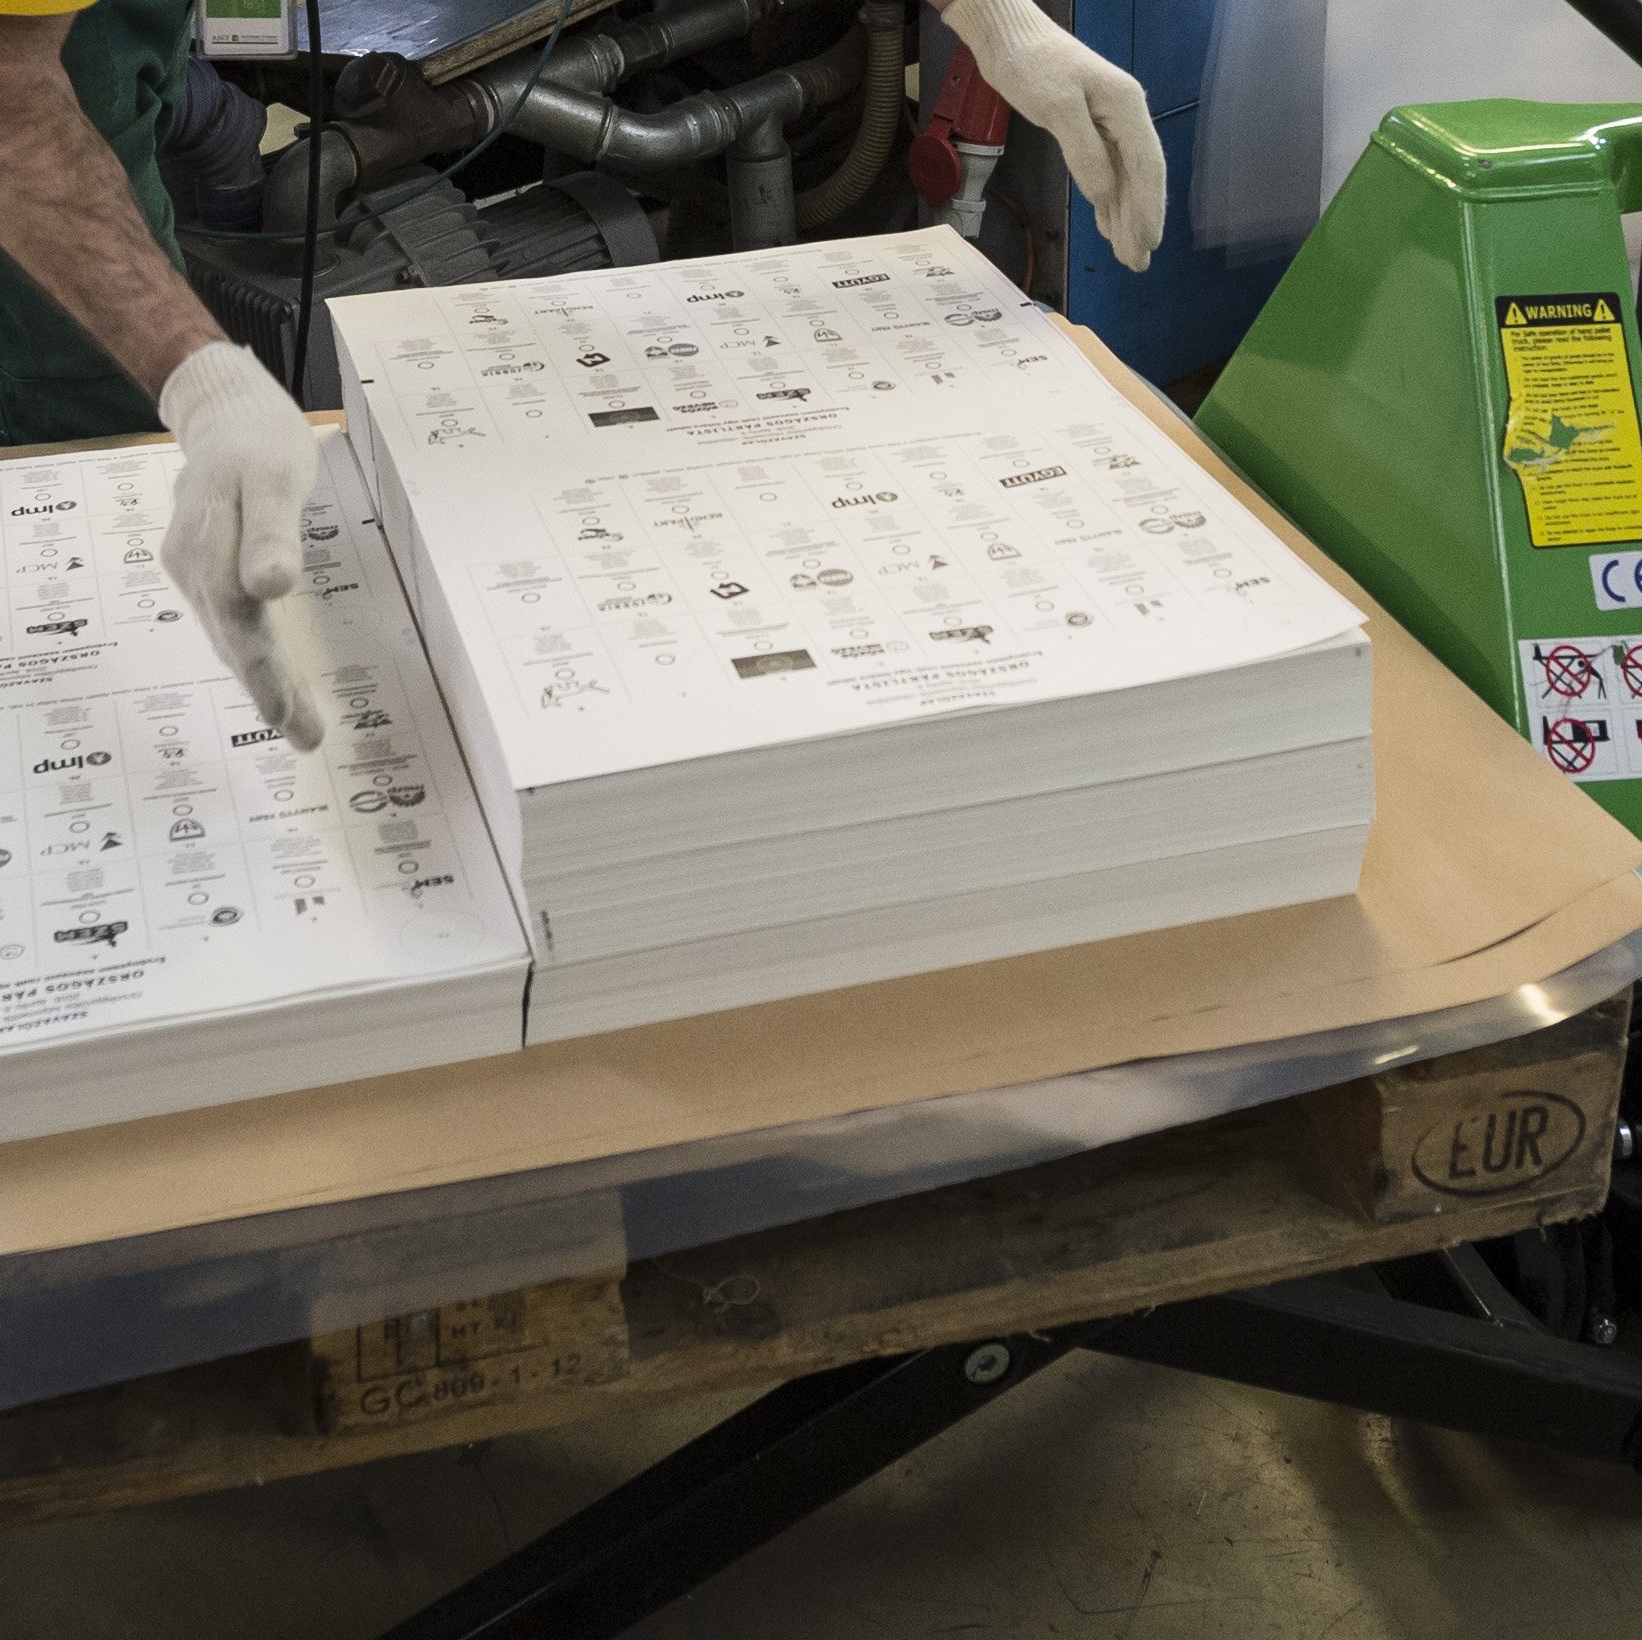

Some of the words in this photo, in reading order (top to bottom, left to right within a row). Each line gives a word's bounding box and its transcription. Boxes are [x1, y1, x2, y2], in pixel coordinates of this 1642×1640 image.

[1525, 303, 1593, 320] WARNING
[33, 755, 83, 775] lmp
[45, 970, 144, 995] ORSZÁGOS
[1448, 1106, 1550, 1179] EUR
